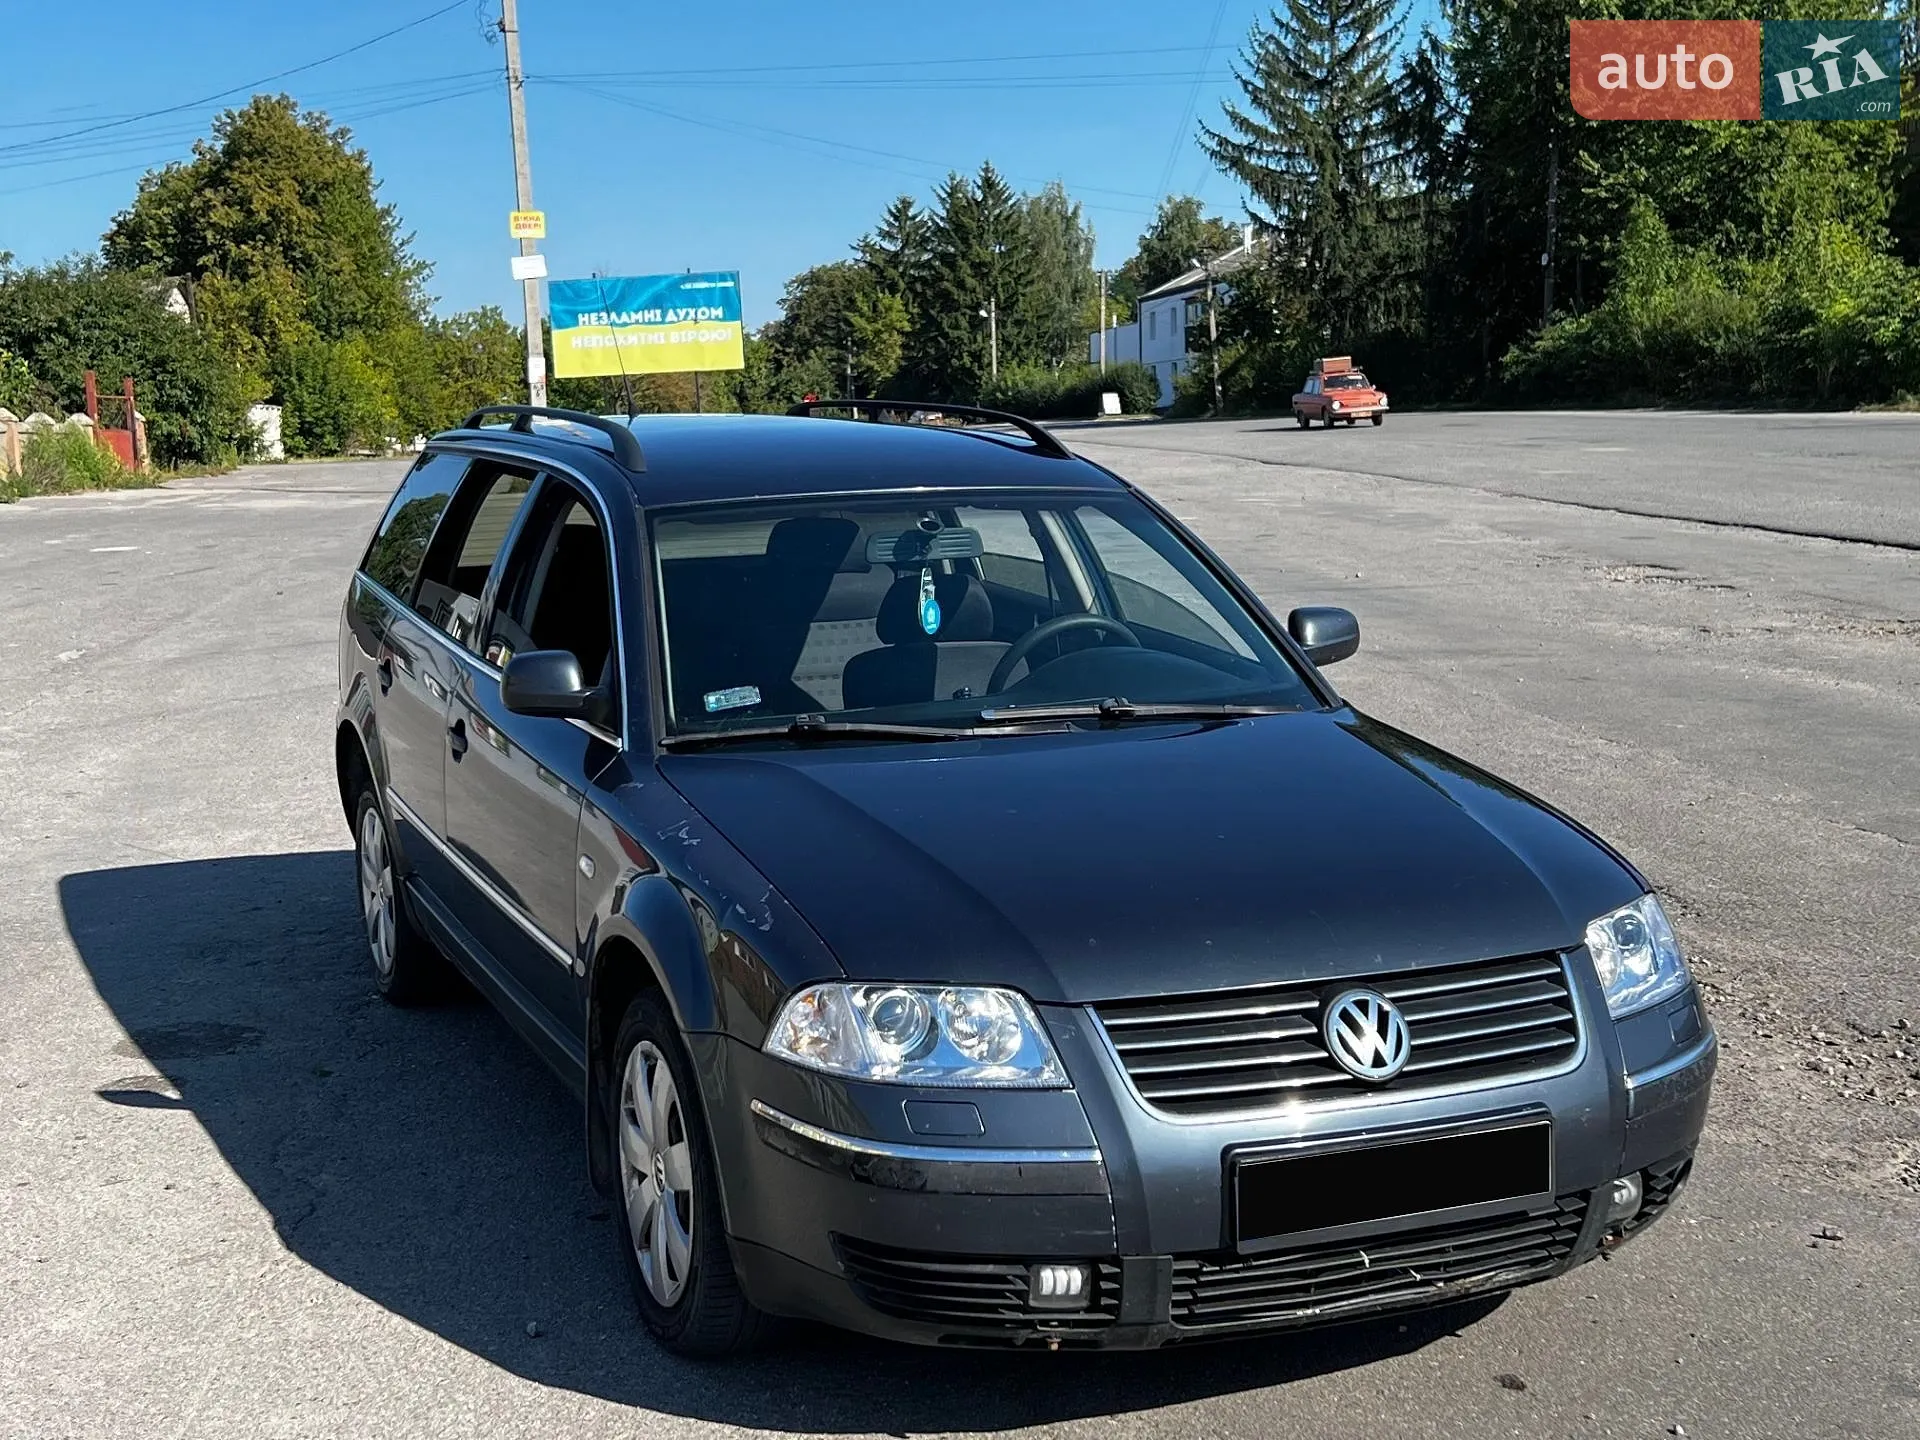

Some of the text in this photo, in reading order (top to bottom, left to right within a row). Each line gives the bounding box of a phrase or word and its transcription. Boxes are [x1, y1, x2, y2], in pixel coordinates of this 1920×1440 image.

[578, 306, 723, 326] НЕЗЛАМНІ ДУХОМ
[572, 332, 665, 348] НЕПОХИТНІ
